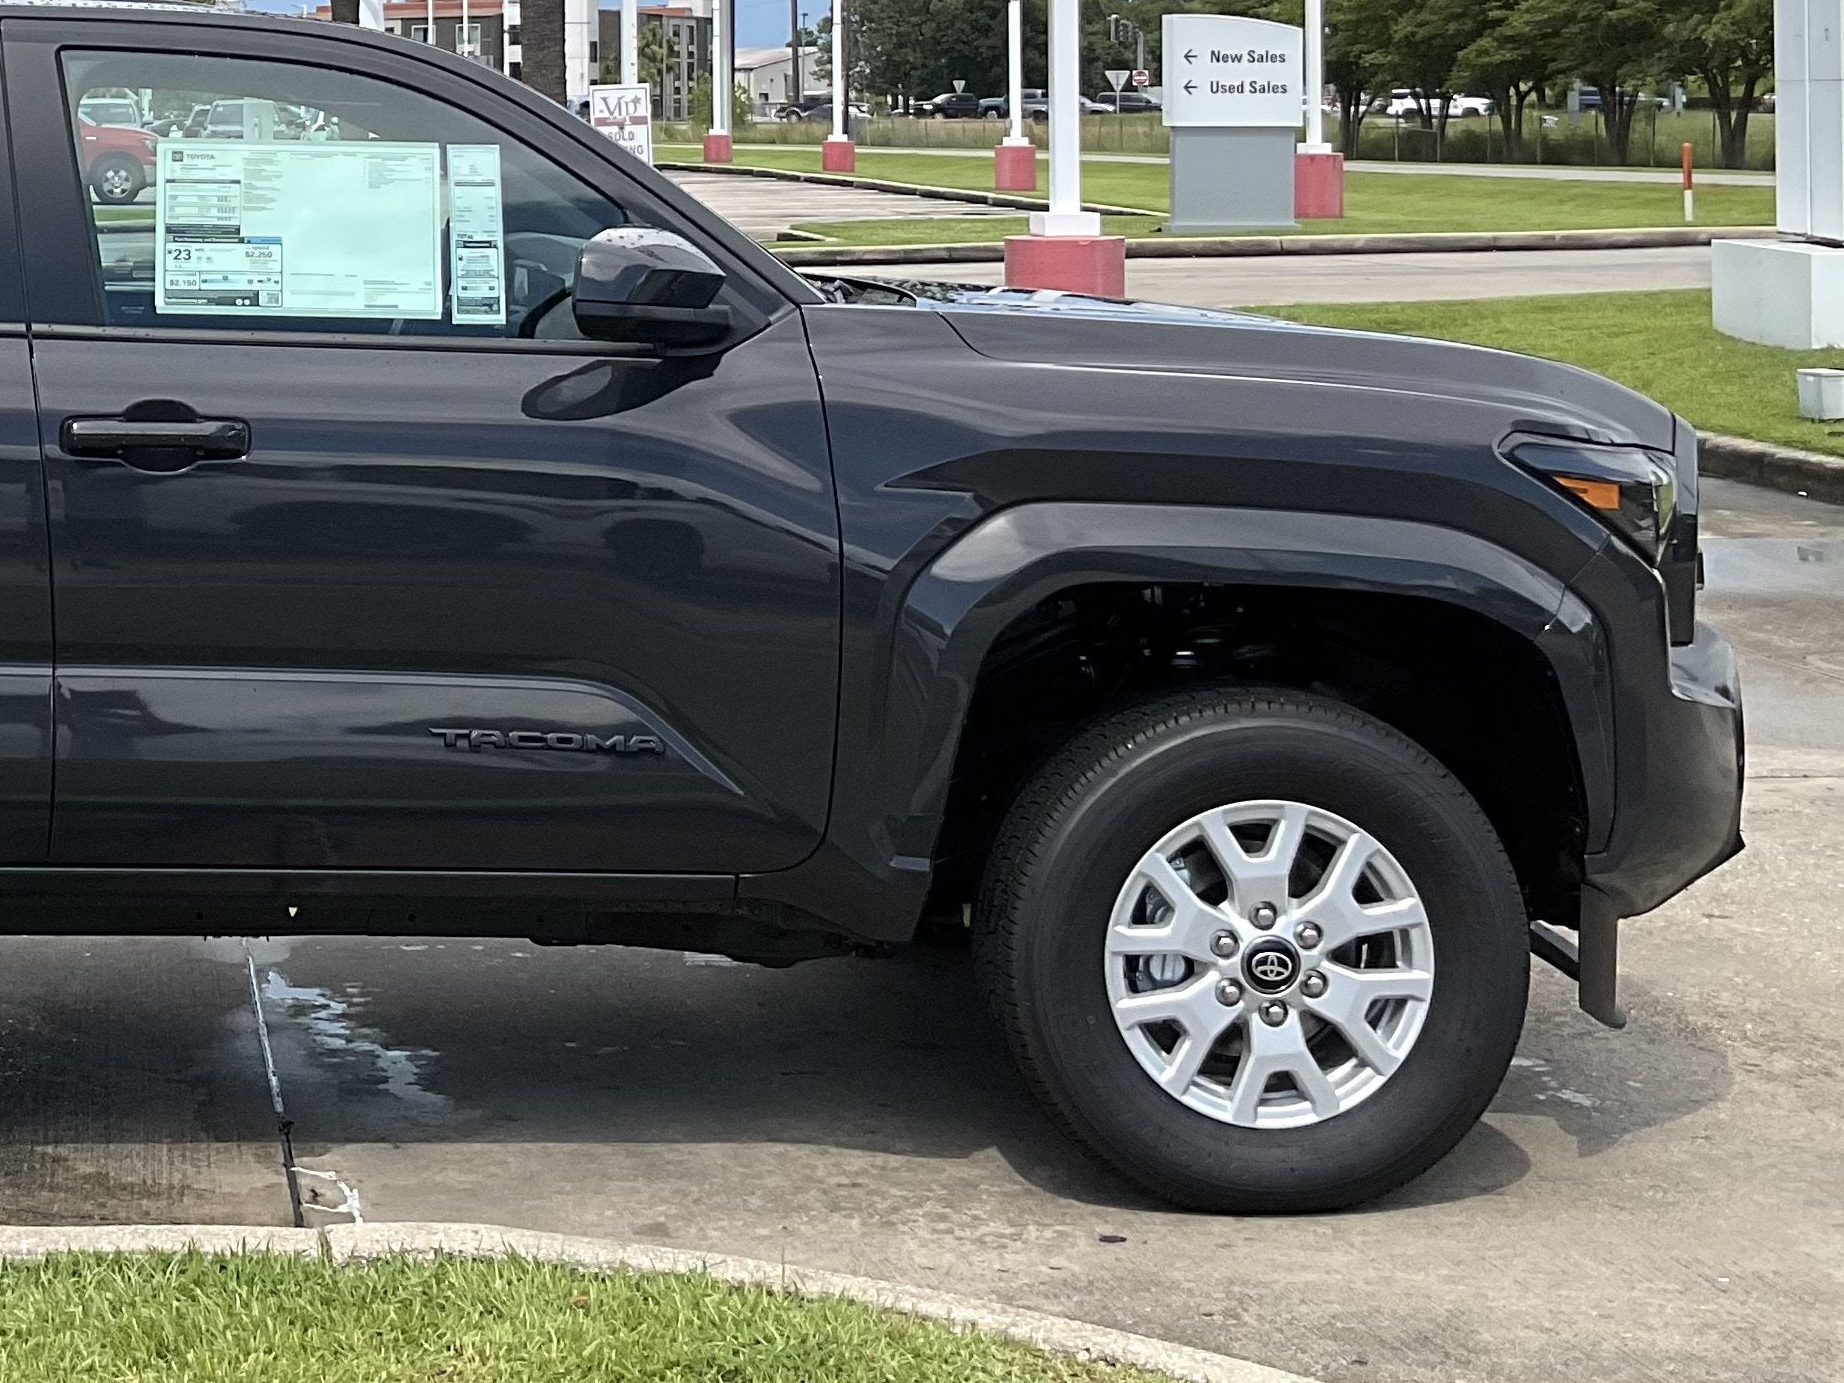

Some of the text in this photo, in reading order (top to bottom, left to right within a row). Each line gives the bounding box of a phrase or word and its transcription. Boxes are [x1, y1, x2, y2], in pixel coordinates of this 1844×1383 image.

[1210, 49, 1286, 64] New Sales
[1209, 80, 1288, 94] Used Sales
[173, 248, 192, 261] 23
[428, 727, 667, 753] TACOMA
